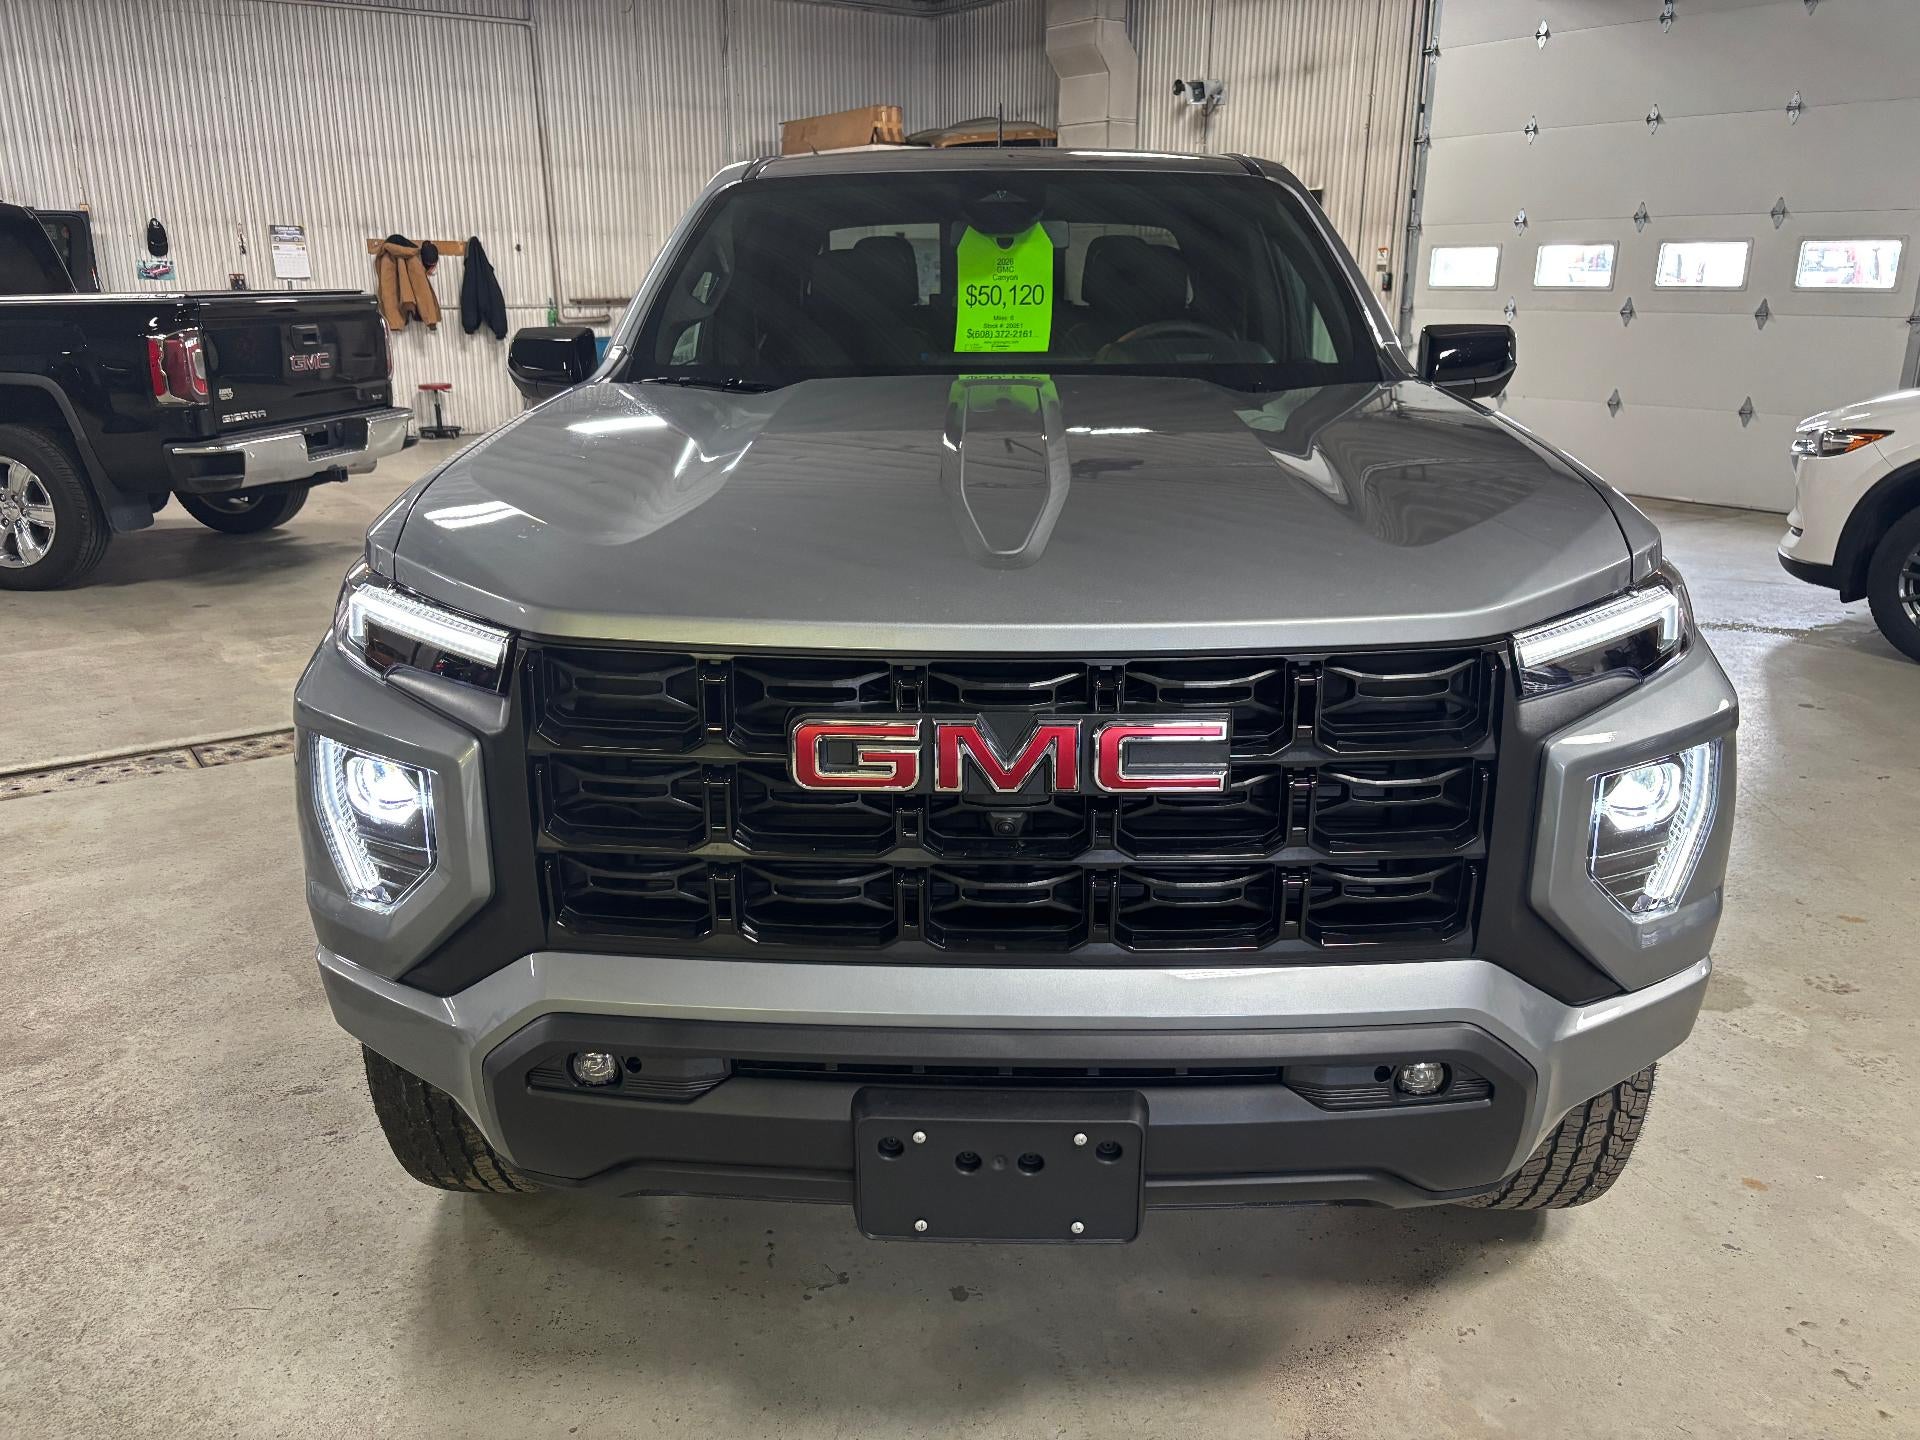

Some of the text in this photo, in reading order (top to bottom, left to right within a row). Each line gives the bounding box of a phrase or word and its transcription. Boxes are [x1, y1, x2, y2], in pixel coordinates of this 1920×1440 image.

[996, 257, 1014, 266] 2026
[992, 274, 1019, 282] Canyon
[966, 284, 1045, 309] $50,120
[995, 330, 1033, 338] 372-2161
[290, 352, 332, 372] GMC
[222, 410, 267, 424] SIERRA
[790, 713, 1229, 793] GMC
